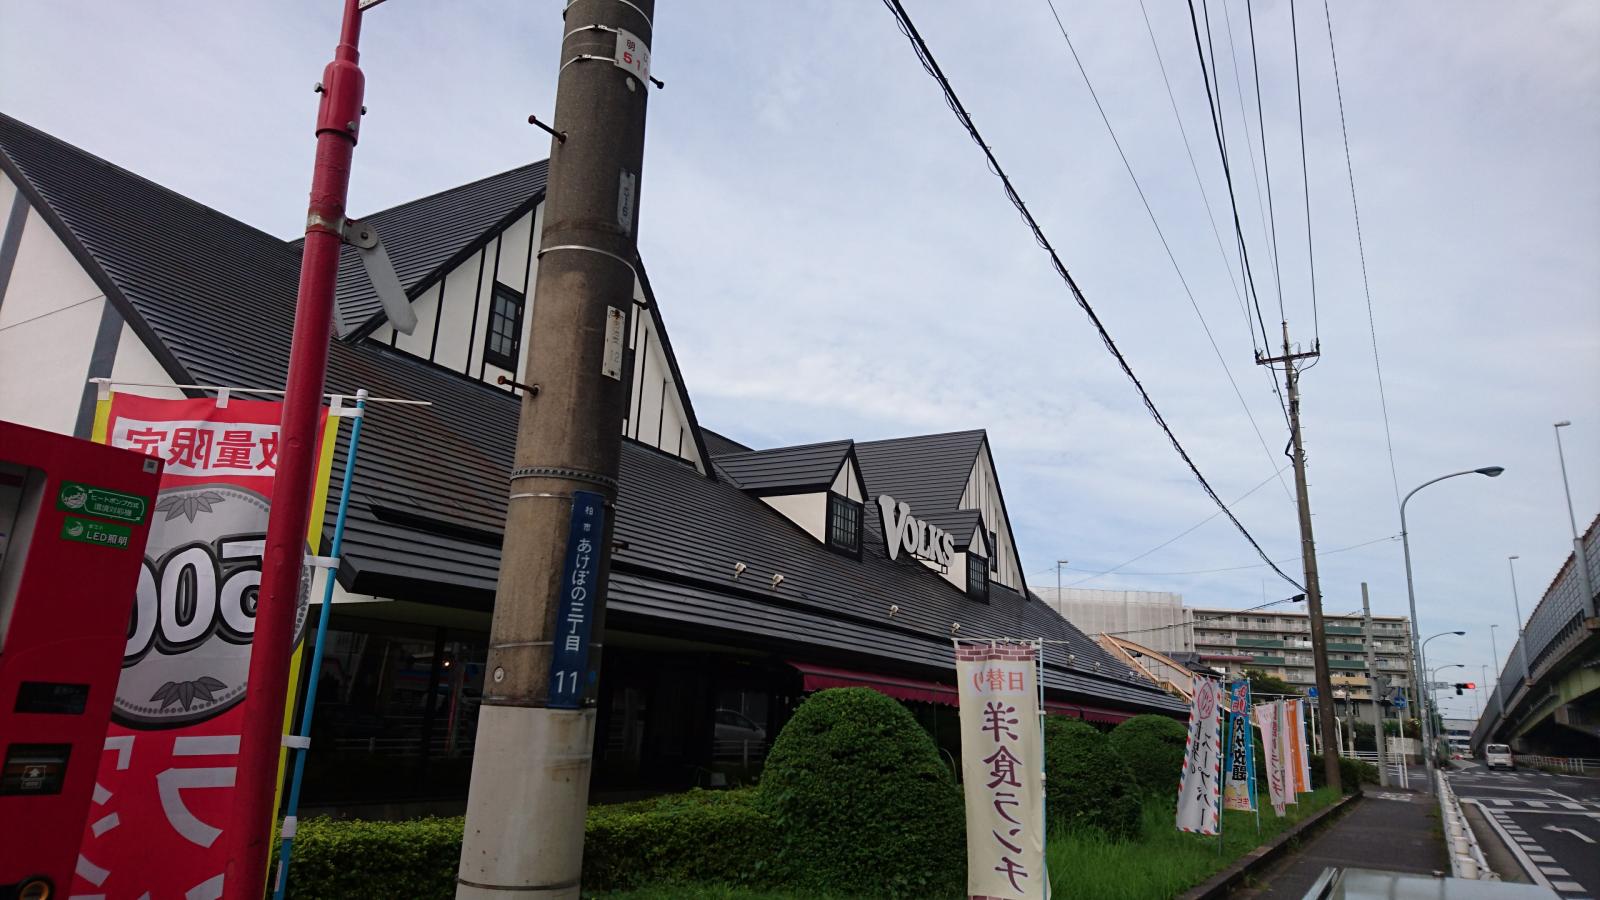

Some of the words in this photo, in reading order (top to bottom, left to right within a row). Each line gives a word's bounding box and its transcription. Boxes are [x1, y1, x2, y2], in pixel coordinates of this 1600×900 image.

[86, 531, 128, 546] LED照明
[877, 494, 955, 568] VOLKS
[564, 538, 593, 652] あけぼの三丁目
[555, 670, 579, 694] 11
